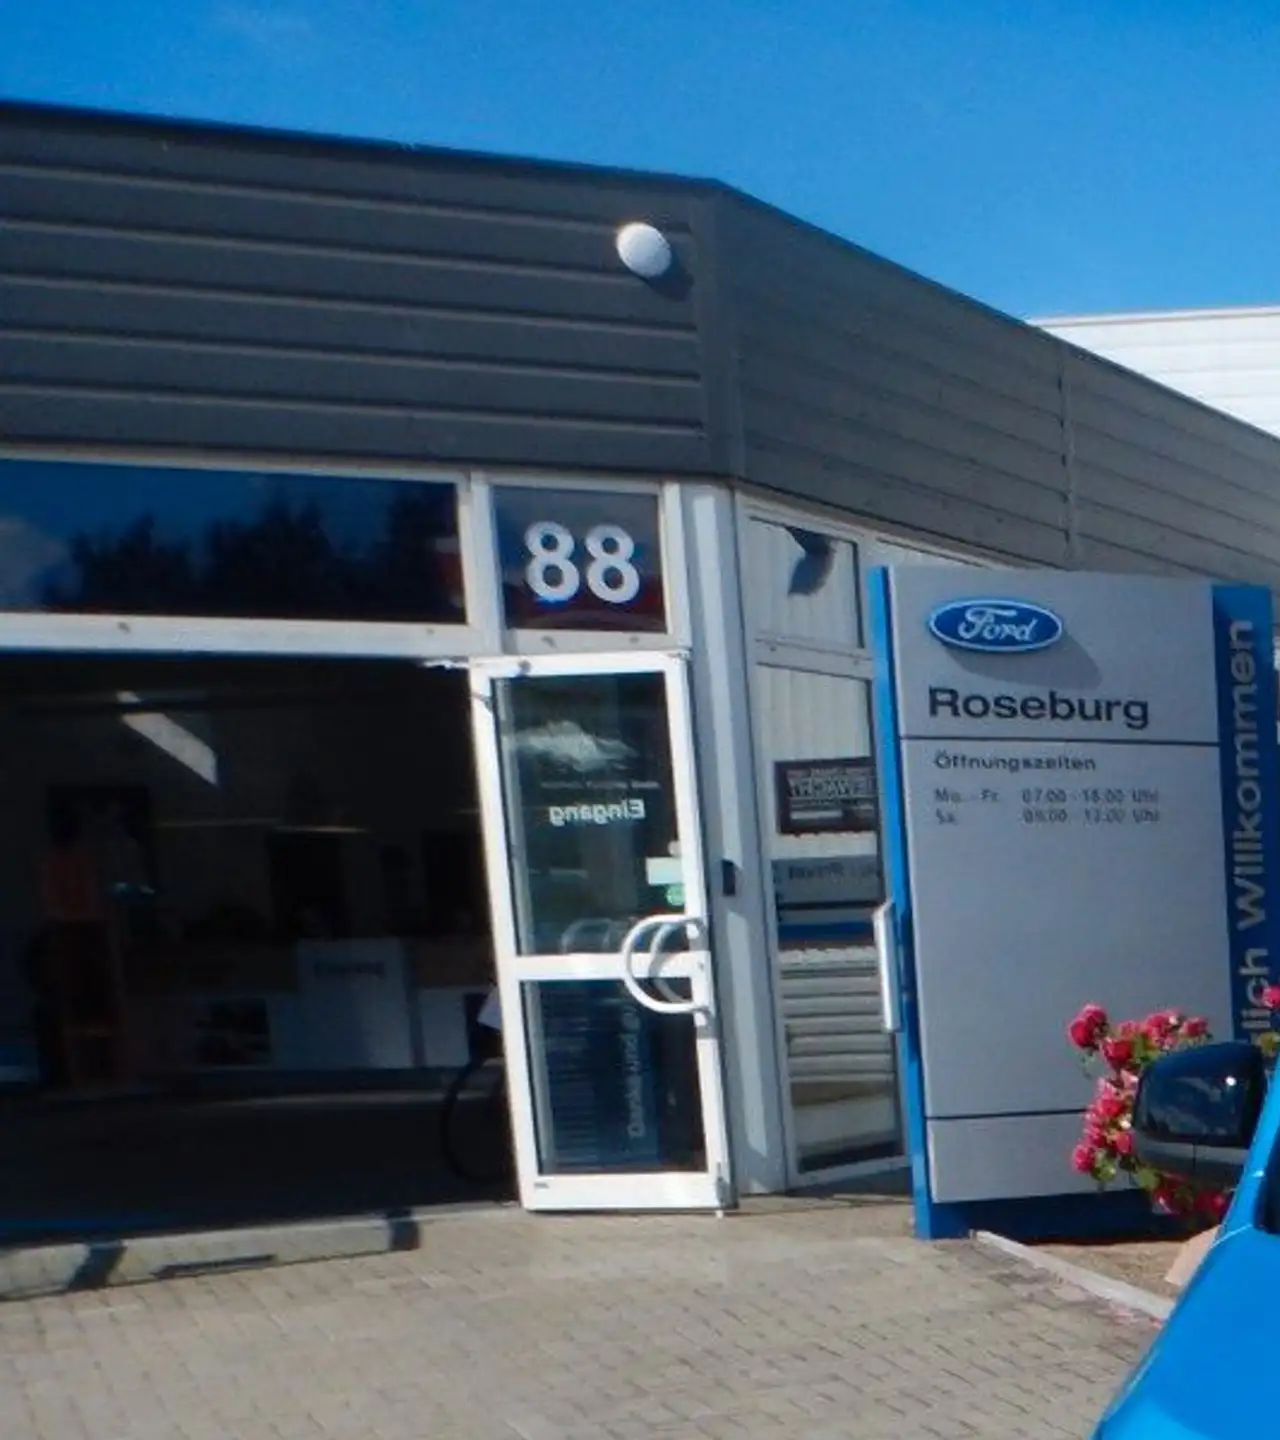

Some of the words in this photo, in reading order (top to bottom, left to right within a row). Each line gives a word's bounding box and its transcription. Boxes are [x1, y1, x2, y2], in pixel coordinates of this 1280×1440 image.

[524, 521, 640, 603] 88
[957, 604, 1037, 645] Ford
[928, 687, 1150, 731] Roseburg
[934, 751, 1097, 773] Öffnungszeiten
[1229, 619, 1268, 931] Willkommen
